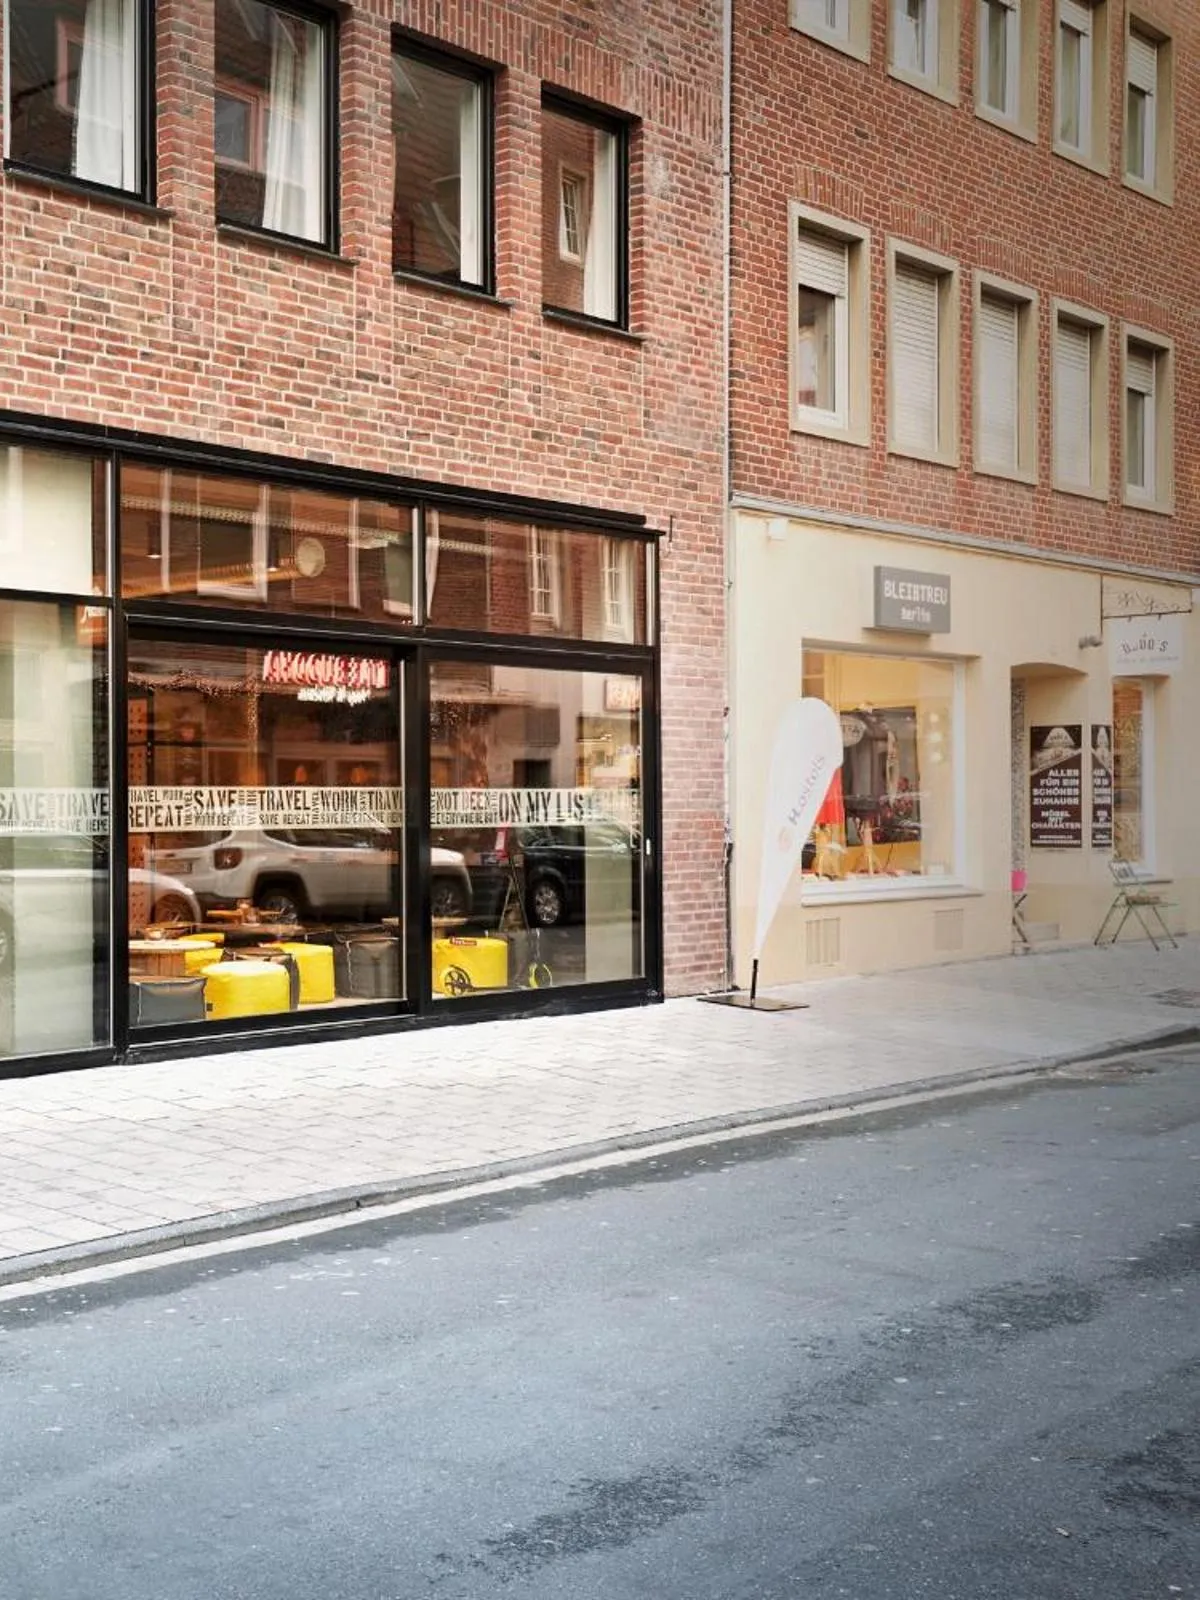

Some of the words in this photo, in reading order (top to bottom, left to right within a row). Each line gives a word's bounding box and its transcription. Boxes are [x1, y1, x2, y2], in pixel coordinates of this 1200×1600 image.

[129, 790, 159, 803] RAVEL
[194, 790, 236, 812] SAVE
[258, 790, 310, 811] TRAVEL
[320, 790, 357, 811] WORK
[437, 791, 458, 810] NOT
[499, 792, 522, 823] ON
[527, 792, 551, 823] MY
[259, 814, 278, 825] SAVE
[283, 813, 310, 825] REPEAT
